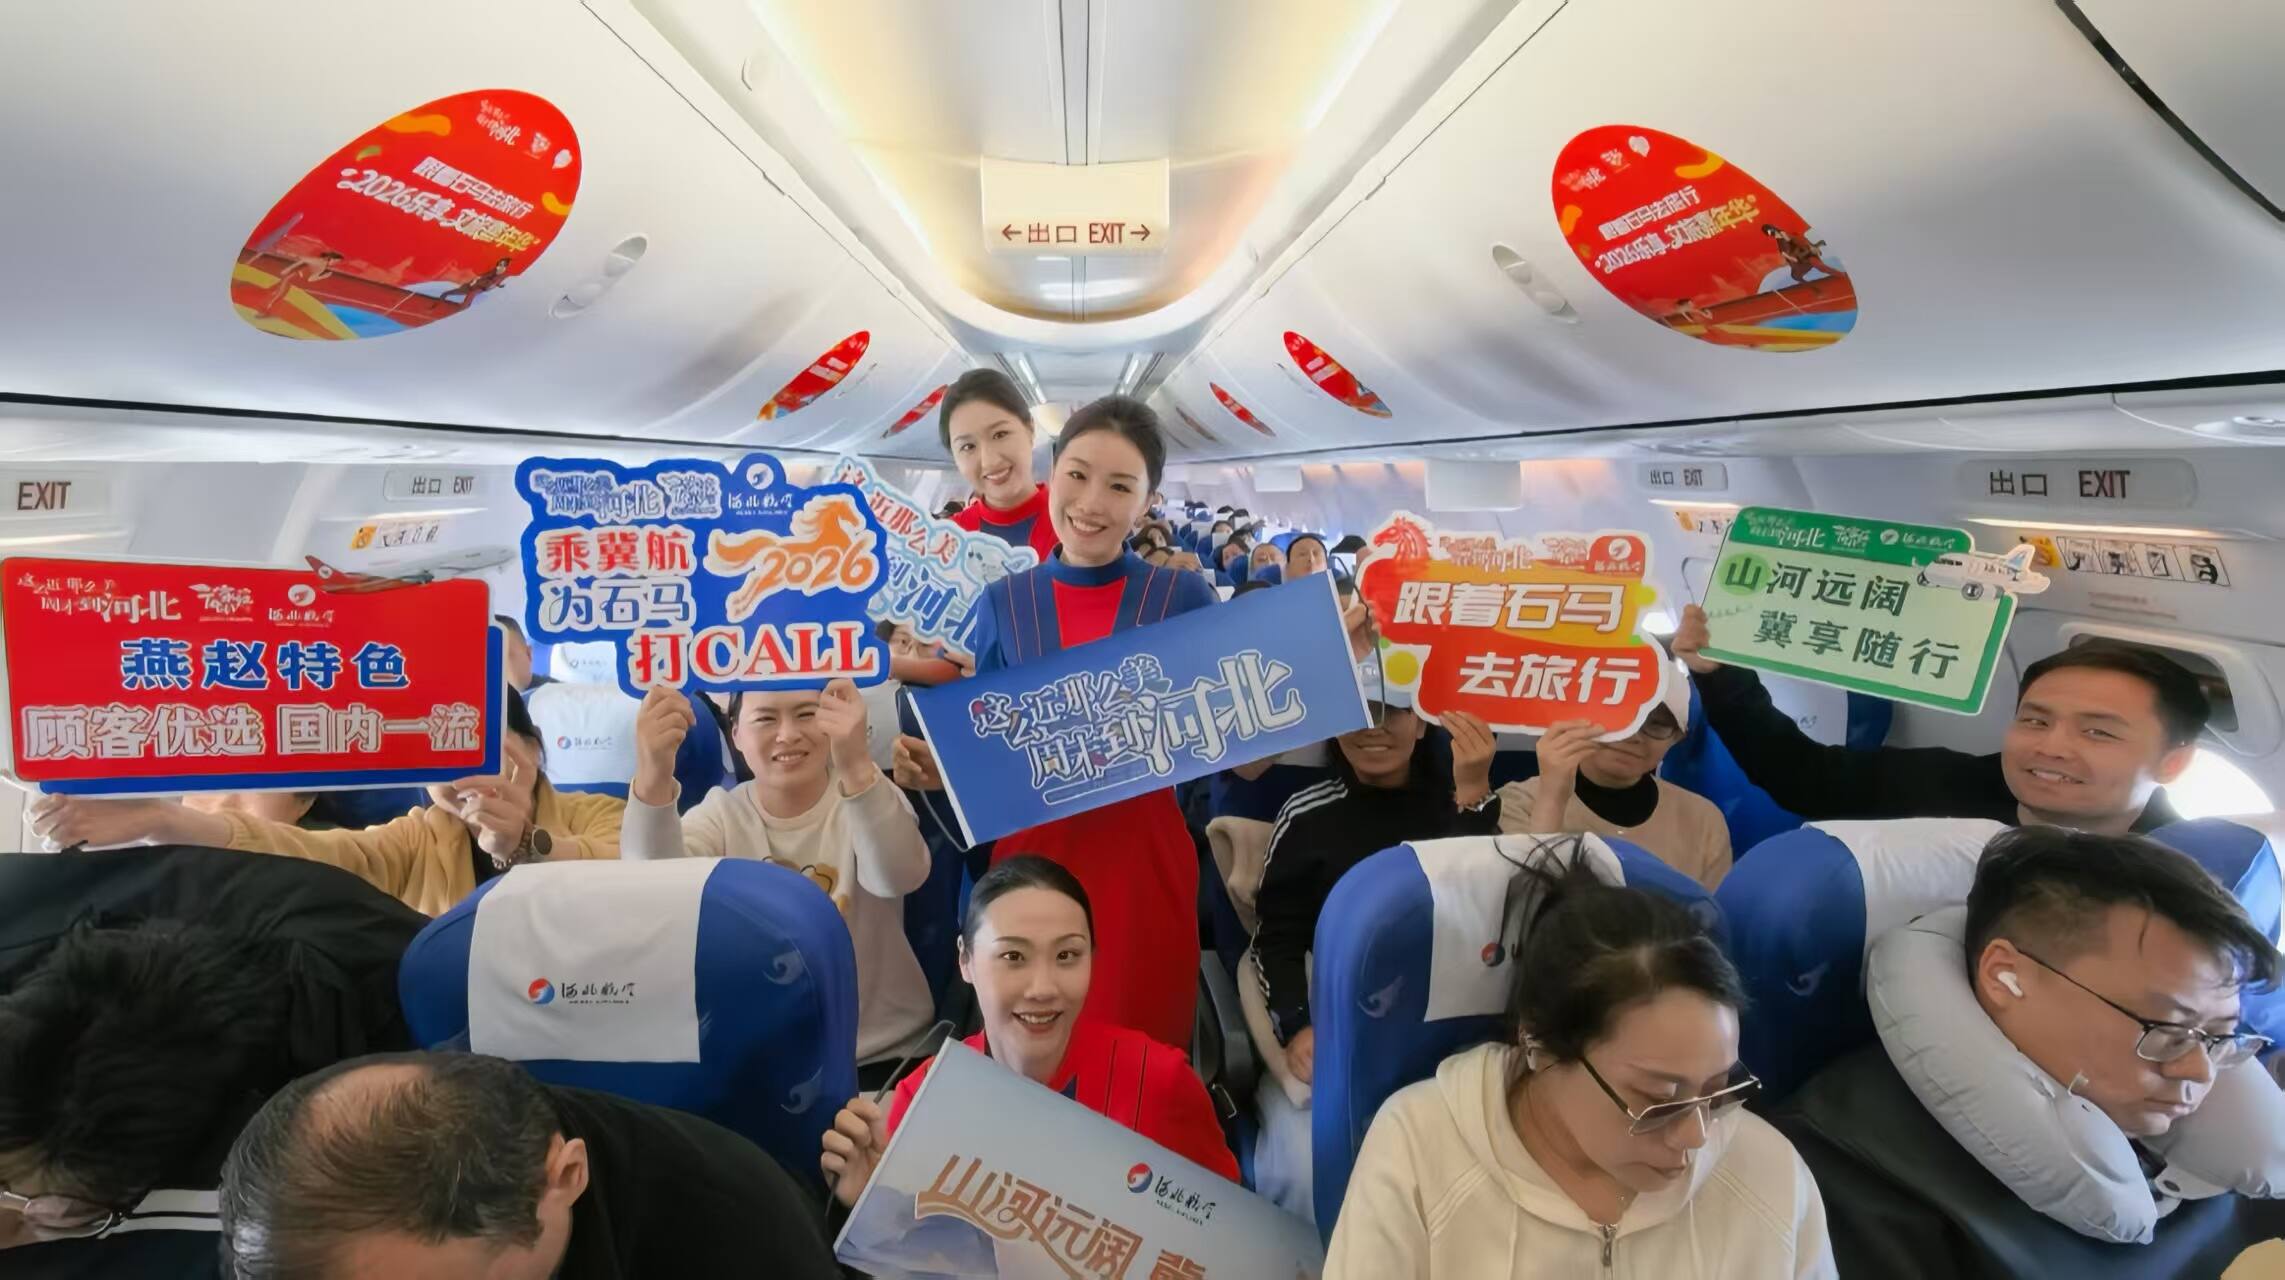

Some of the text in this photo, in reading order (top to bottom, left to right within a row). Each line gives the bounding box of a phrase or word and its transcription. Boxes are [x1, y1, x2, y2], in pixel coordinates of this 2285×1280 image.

[1028, 222, 1125, 244] 出口 EXIT
[17, 481, 71, 510] EXIT
[412, 476, 442, 495] 出口
[1683, 469, 1703, 486] EXIT
[1990, 470, 2131, 498] 出口 EXIT
[546, 531, 690, 574] 乘冀航
[763, 540, 872, 590] 2026
[549, 582, 689, 625] 为石马
[1393, 582, 1625, 633] 跟着石马
[1724, 557, 1910, 616] 山河远阔
[121, 637, 409, 690] 燕赵特色
[1753, 610, 1960, 679] 冀享随行
[1457, 652, 1641, 705] 去旅行
[22, 702, 481, 760] 顾客优选 国内一流
